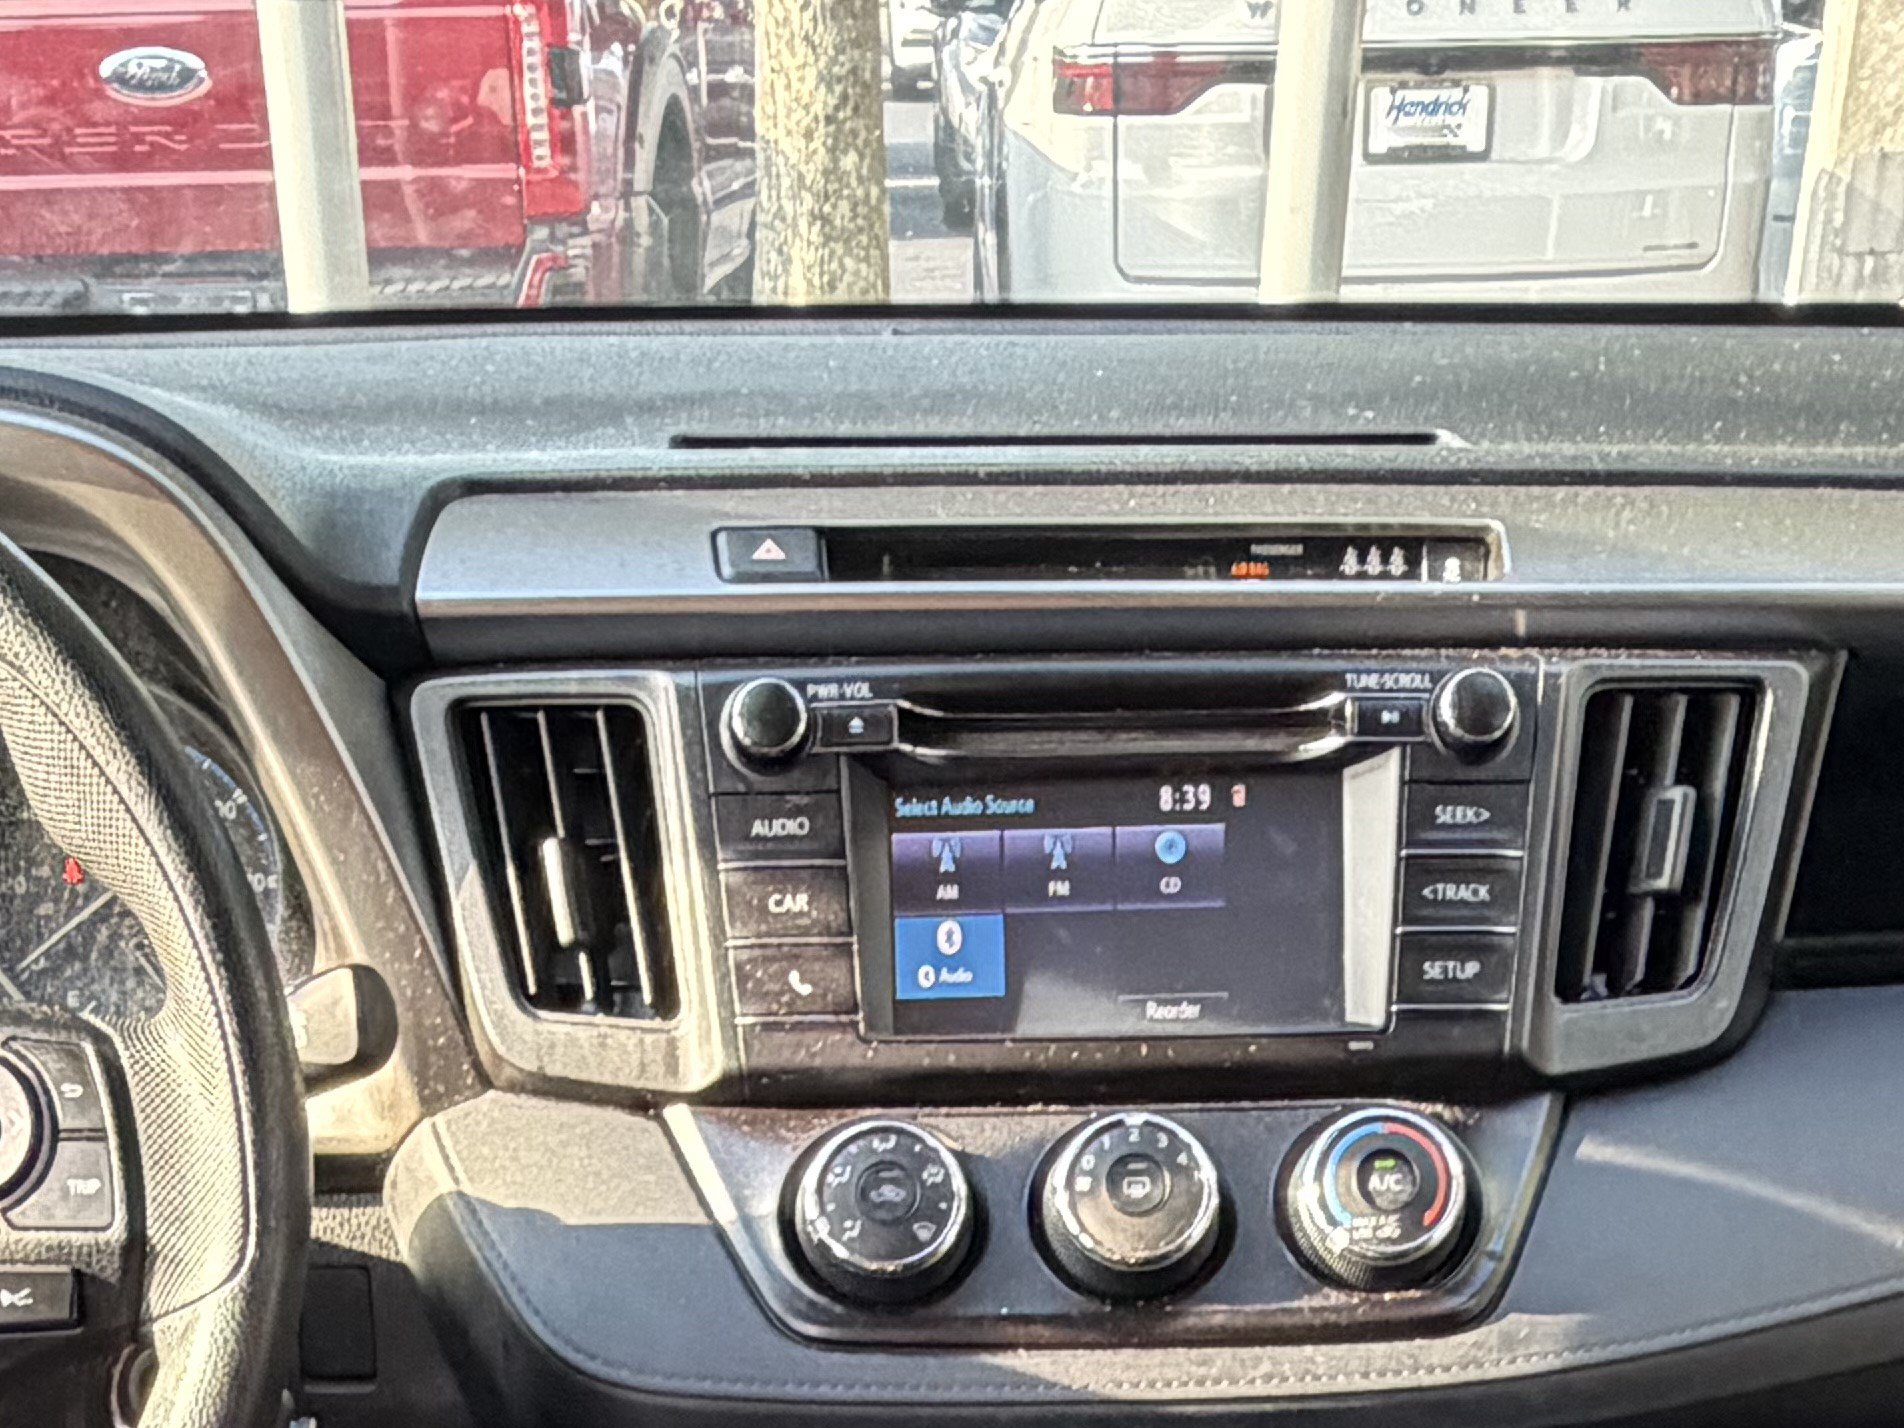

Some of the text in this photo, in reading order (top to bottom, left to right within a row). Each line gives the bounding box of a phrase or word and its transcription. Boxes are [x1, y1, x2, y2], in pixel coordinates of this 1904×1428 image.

[1246, 0, 1631, 19] WONEER
[1385, 89, 1471, 126] Hendrick
[894, 794, 1036, 818] Select Audio Source
[1158, 783, 1212, 813] 8:39
[750, 815, 811, 838] AUDIO
[936, 884, 960, 901] AM
[1048, 880, 1071, 898] FM
[1158, 876, 1183, 895] CD
[767, 892, 810, 914] CAR
[938, 967, 974, 985] Audio
[1422, 959, 1482, 981] SETUP
[1145, 1000, 1201, 1022] Reorder
[1128, 1128, 1139, 1142] 2
[1156, 1132, 1169, 1148] 3
[1176, 1151, 1188, 1166] 4
[67, 1178, 102, 1196] TRIP
[1368, 1172, 1404, 1192] A/C
